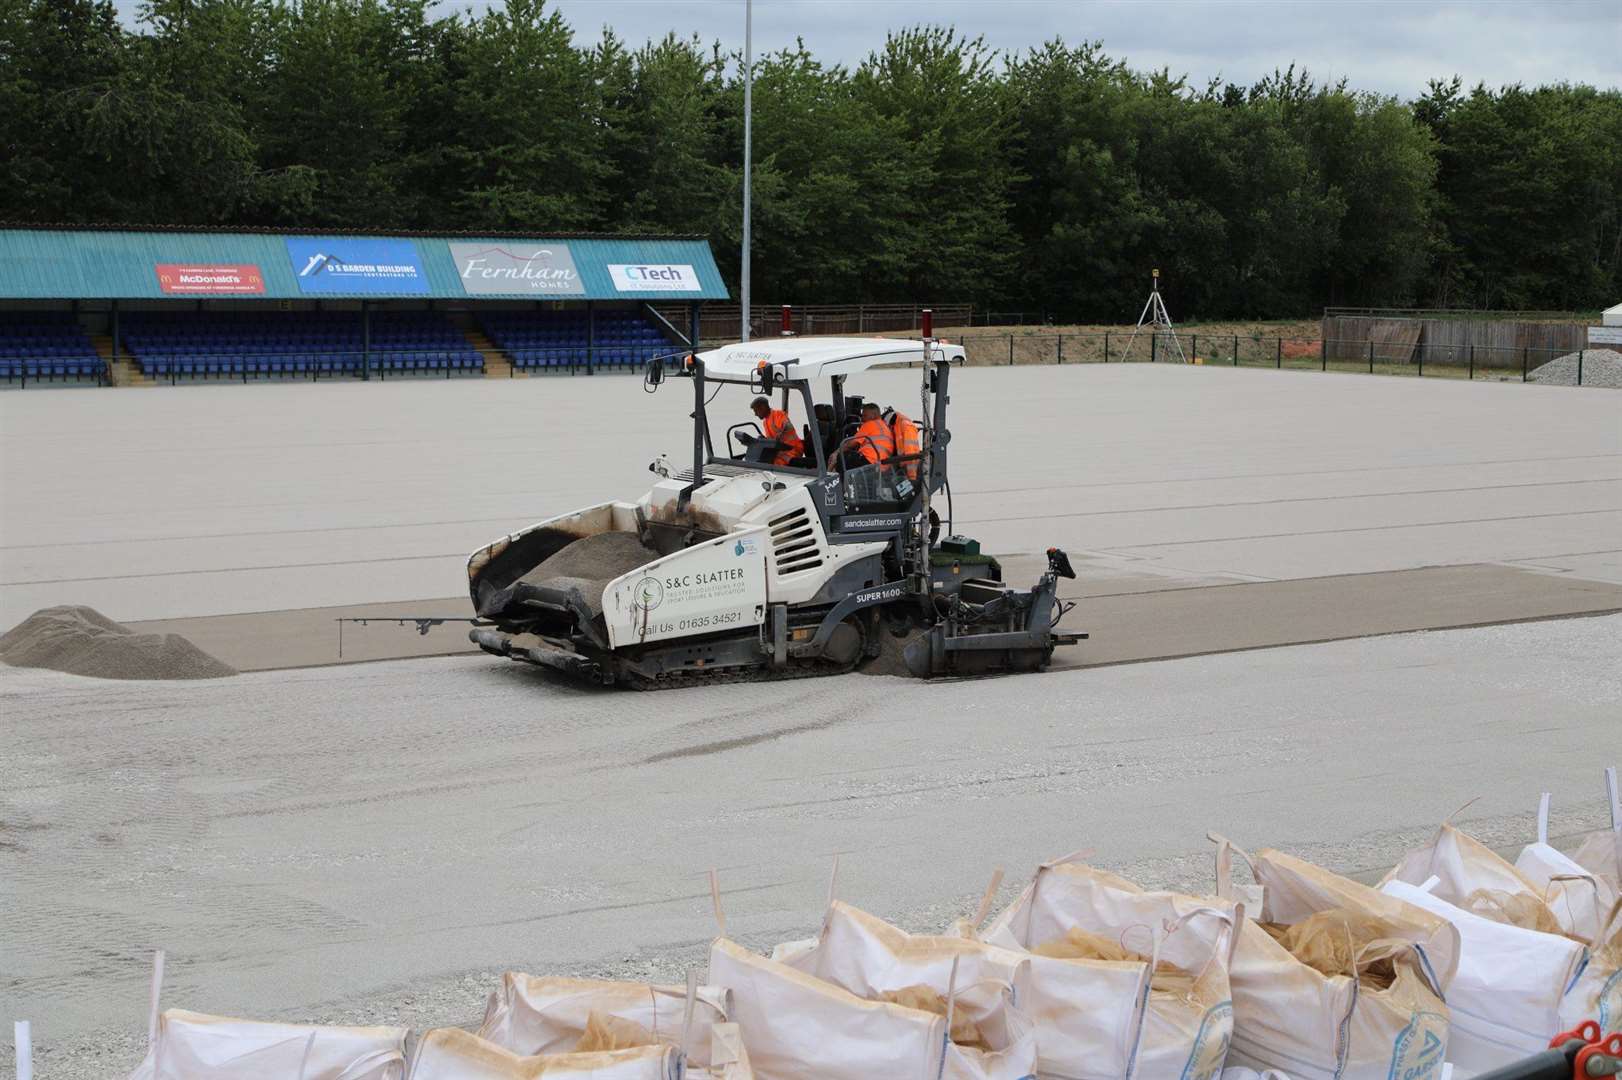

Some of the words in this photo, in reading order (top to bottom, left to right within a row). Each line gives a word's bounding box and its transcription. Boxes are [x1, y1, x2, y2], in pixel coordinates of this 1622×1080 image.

[376, 265, 416, 273] BUILDING
[462, 249, 577, 280] Fernham
[179, 275, 241, 283] McDonald's
[624, 266, 682, 280] CTech
[531, 281, 570, 289] HOMES
[844, 518, 902, 528] sandcslatter.com
[665, 575, 690, 589] S&C
[695, 568, 744, 585] SLATTER
[856, 591, 881, 603] SUPER
[638, 625, 657, 637] Call
[660, 622, 674, 633] Us
[679, 616, 710, 630] 01635
[711, 612, 742, 625] 34521
